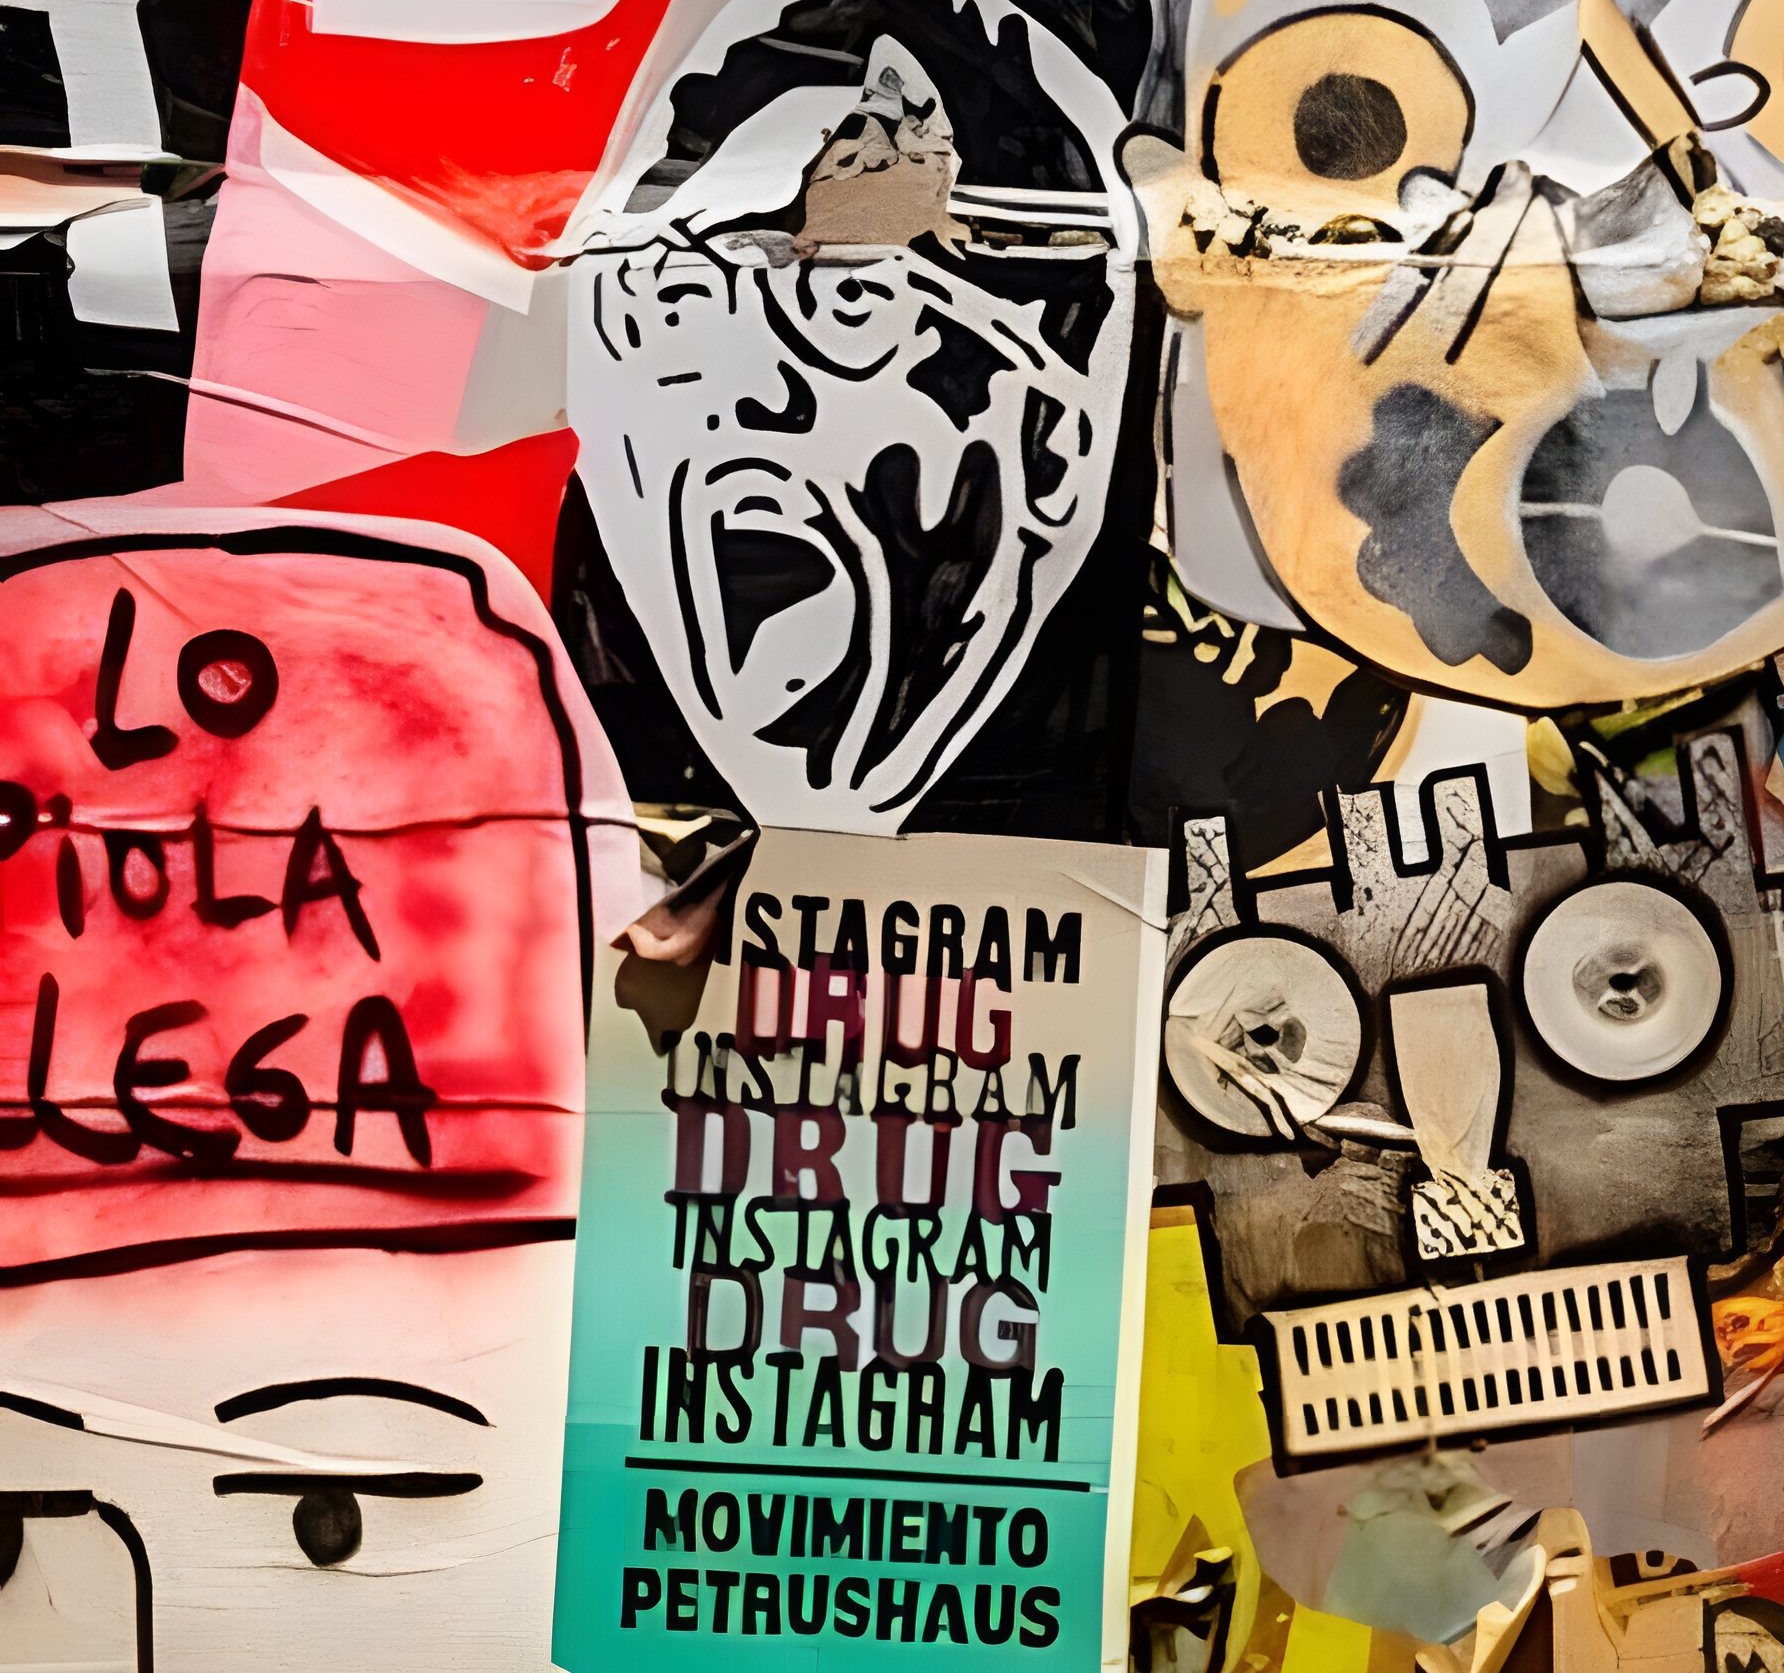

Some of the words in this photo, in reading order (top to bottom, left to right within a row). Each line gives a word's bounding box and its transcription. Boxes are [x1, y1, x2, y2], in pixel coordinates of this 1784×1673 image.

[91, 587, 279, 771] LO
[674, 1105, 1061, 1225] DRUG
[664, 1190, 1052, 1293] INSTAGRAM
[687, 1270, 1040, 1372] DRUG
[639, 1346, 1064, 1462] INSTAGRAM
[643, 1488, 1049, 1567] MOVIMIENTO
[620, 1567, 1061, 1648] PETRUSHAUS
